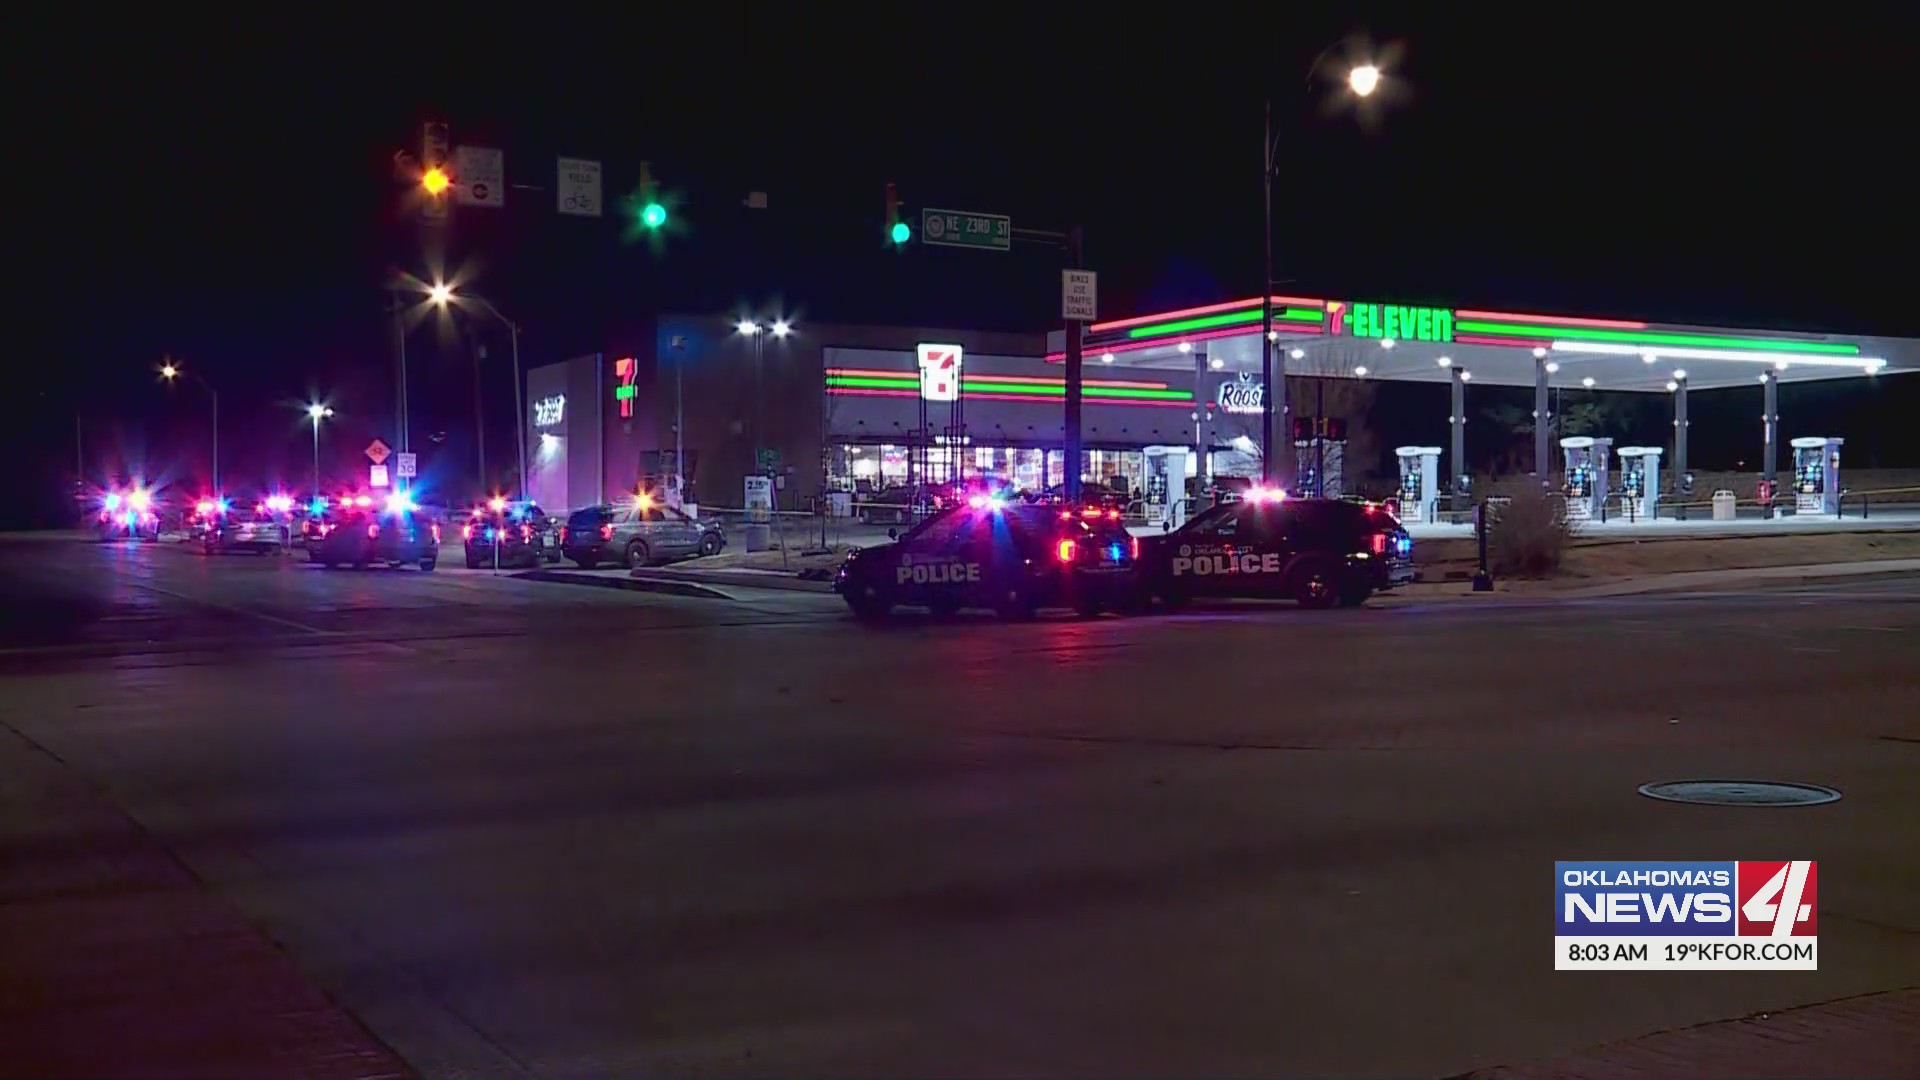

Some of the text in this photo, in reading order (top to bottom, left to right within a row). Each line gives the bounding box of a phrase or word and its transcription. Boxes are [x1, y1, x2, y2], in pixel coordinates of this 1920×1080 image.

[946, 216, 1008, 236] NE 23RD ST
[1067, 296, 1092, 304] TRAFFIC
[1066, 306, 1093, 315] SIGNALS
[896, 563, 981, 584] POLICE
[1173, 553, 1280, 576] POLICE
